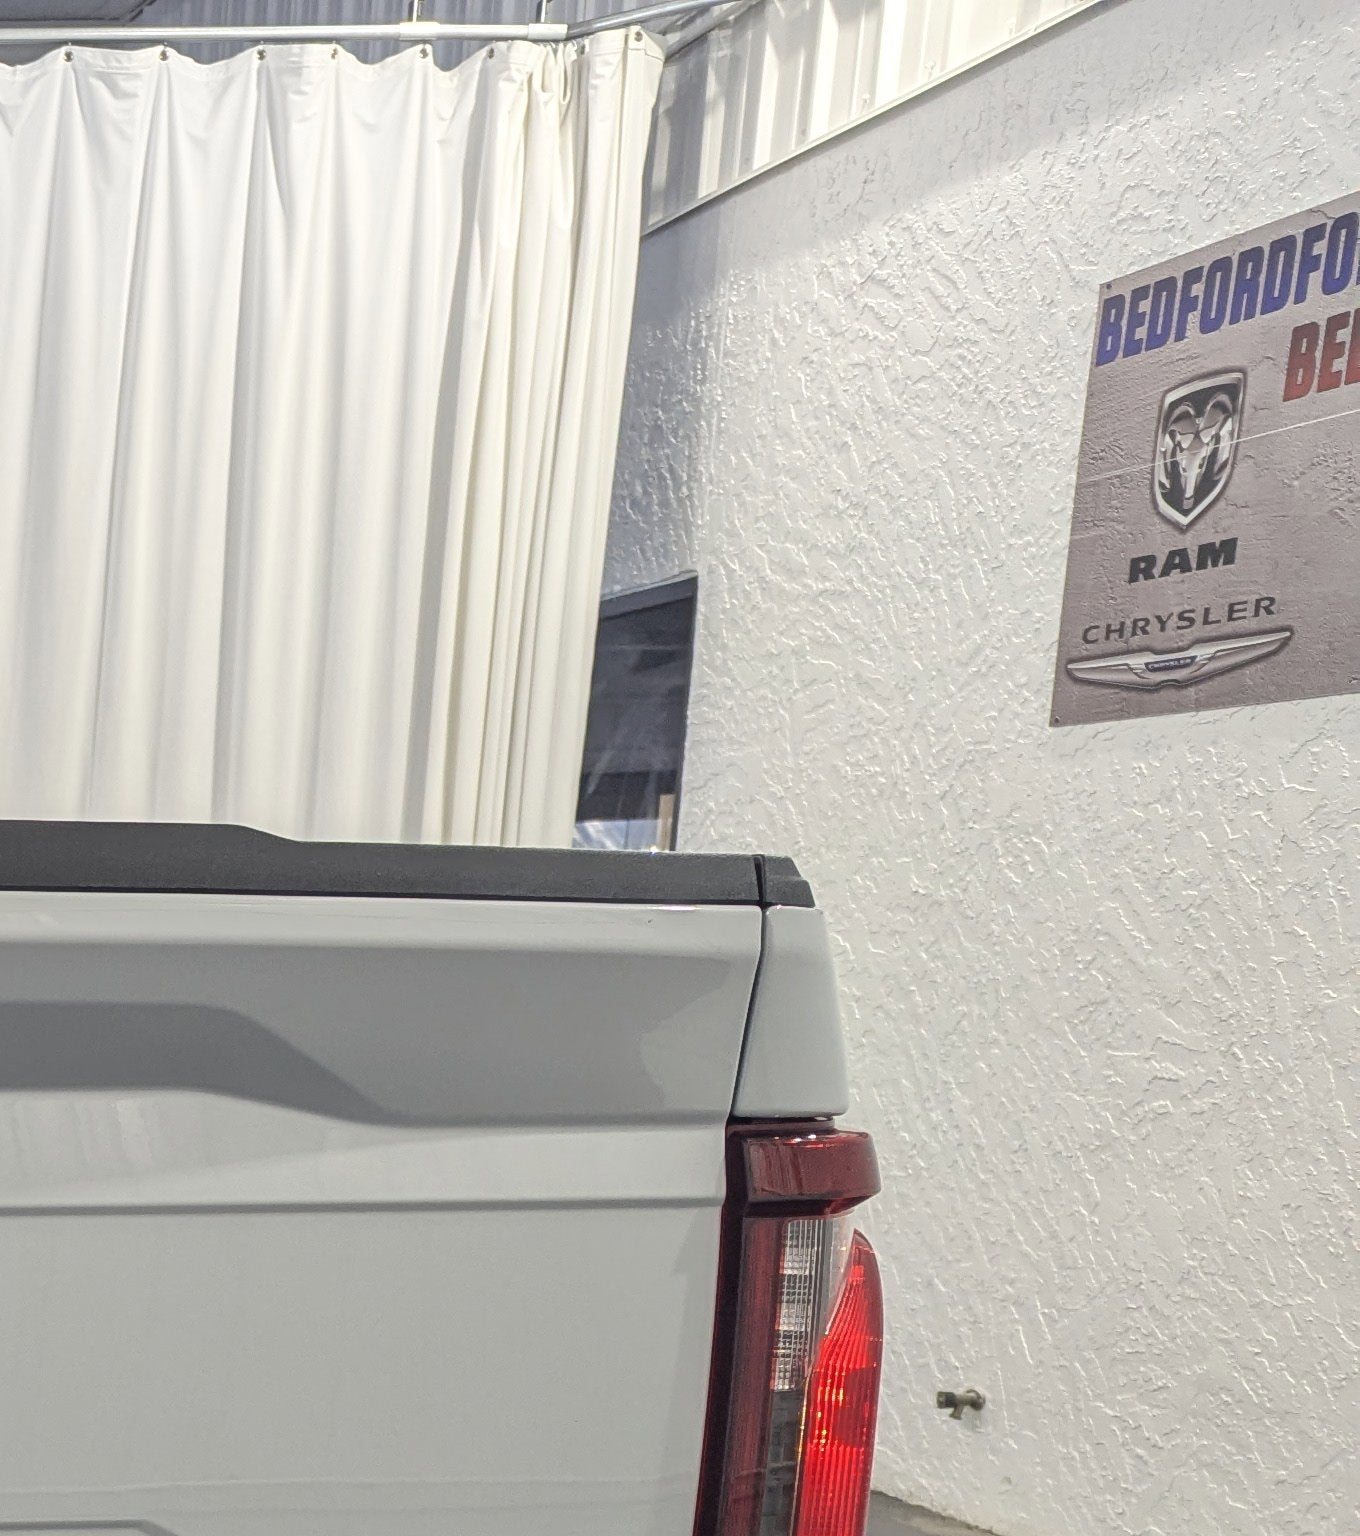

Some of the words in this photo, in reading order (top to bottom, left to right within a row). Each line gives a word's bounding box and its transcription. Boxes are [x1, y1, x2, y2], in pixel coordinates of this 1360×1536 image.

[1095, 211, 1360, 367] BEDFORDFO
[1128, 537, 1238, 583] RAM
[1083, 597, 1276, 644] CHRYSLER
